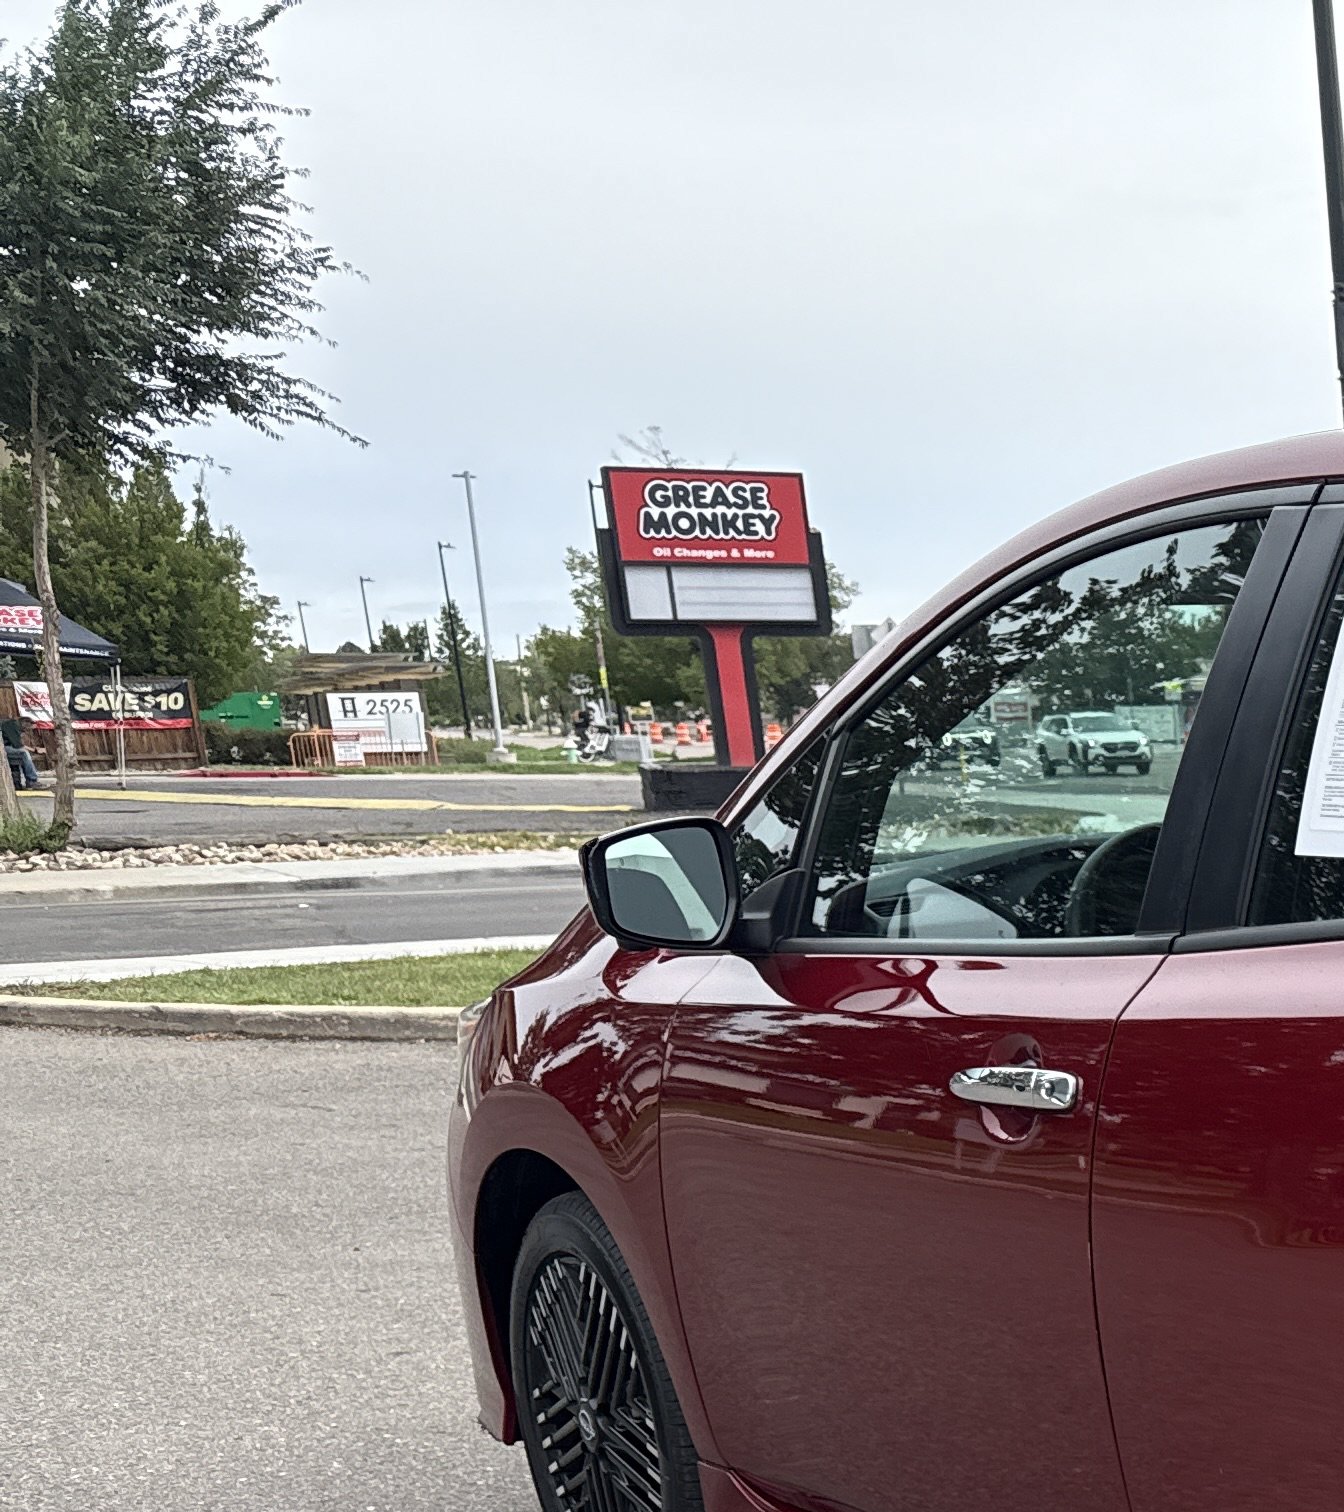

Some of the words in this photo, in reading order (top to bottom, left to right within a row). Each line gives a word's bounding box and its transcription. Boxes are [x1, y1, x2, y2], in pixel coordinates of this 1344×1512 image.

[647, 482, 767, 511] GREASE
[641, 510, 778, 537] MONKEY
[652, 546, 671, 557] Oil
[673, 547, 728, 560] Changes
[730, 548, 741, 558] &
[743, 548, 775, 558] More
[74, 692, 140, 712] SAVE
[144, 691, 185, 711] $10
[366, 698, 413, 716] 2525
